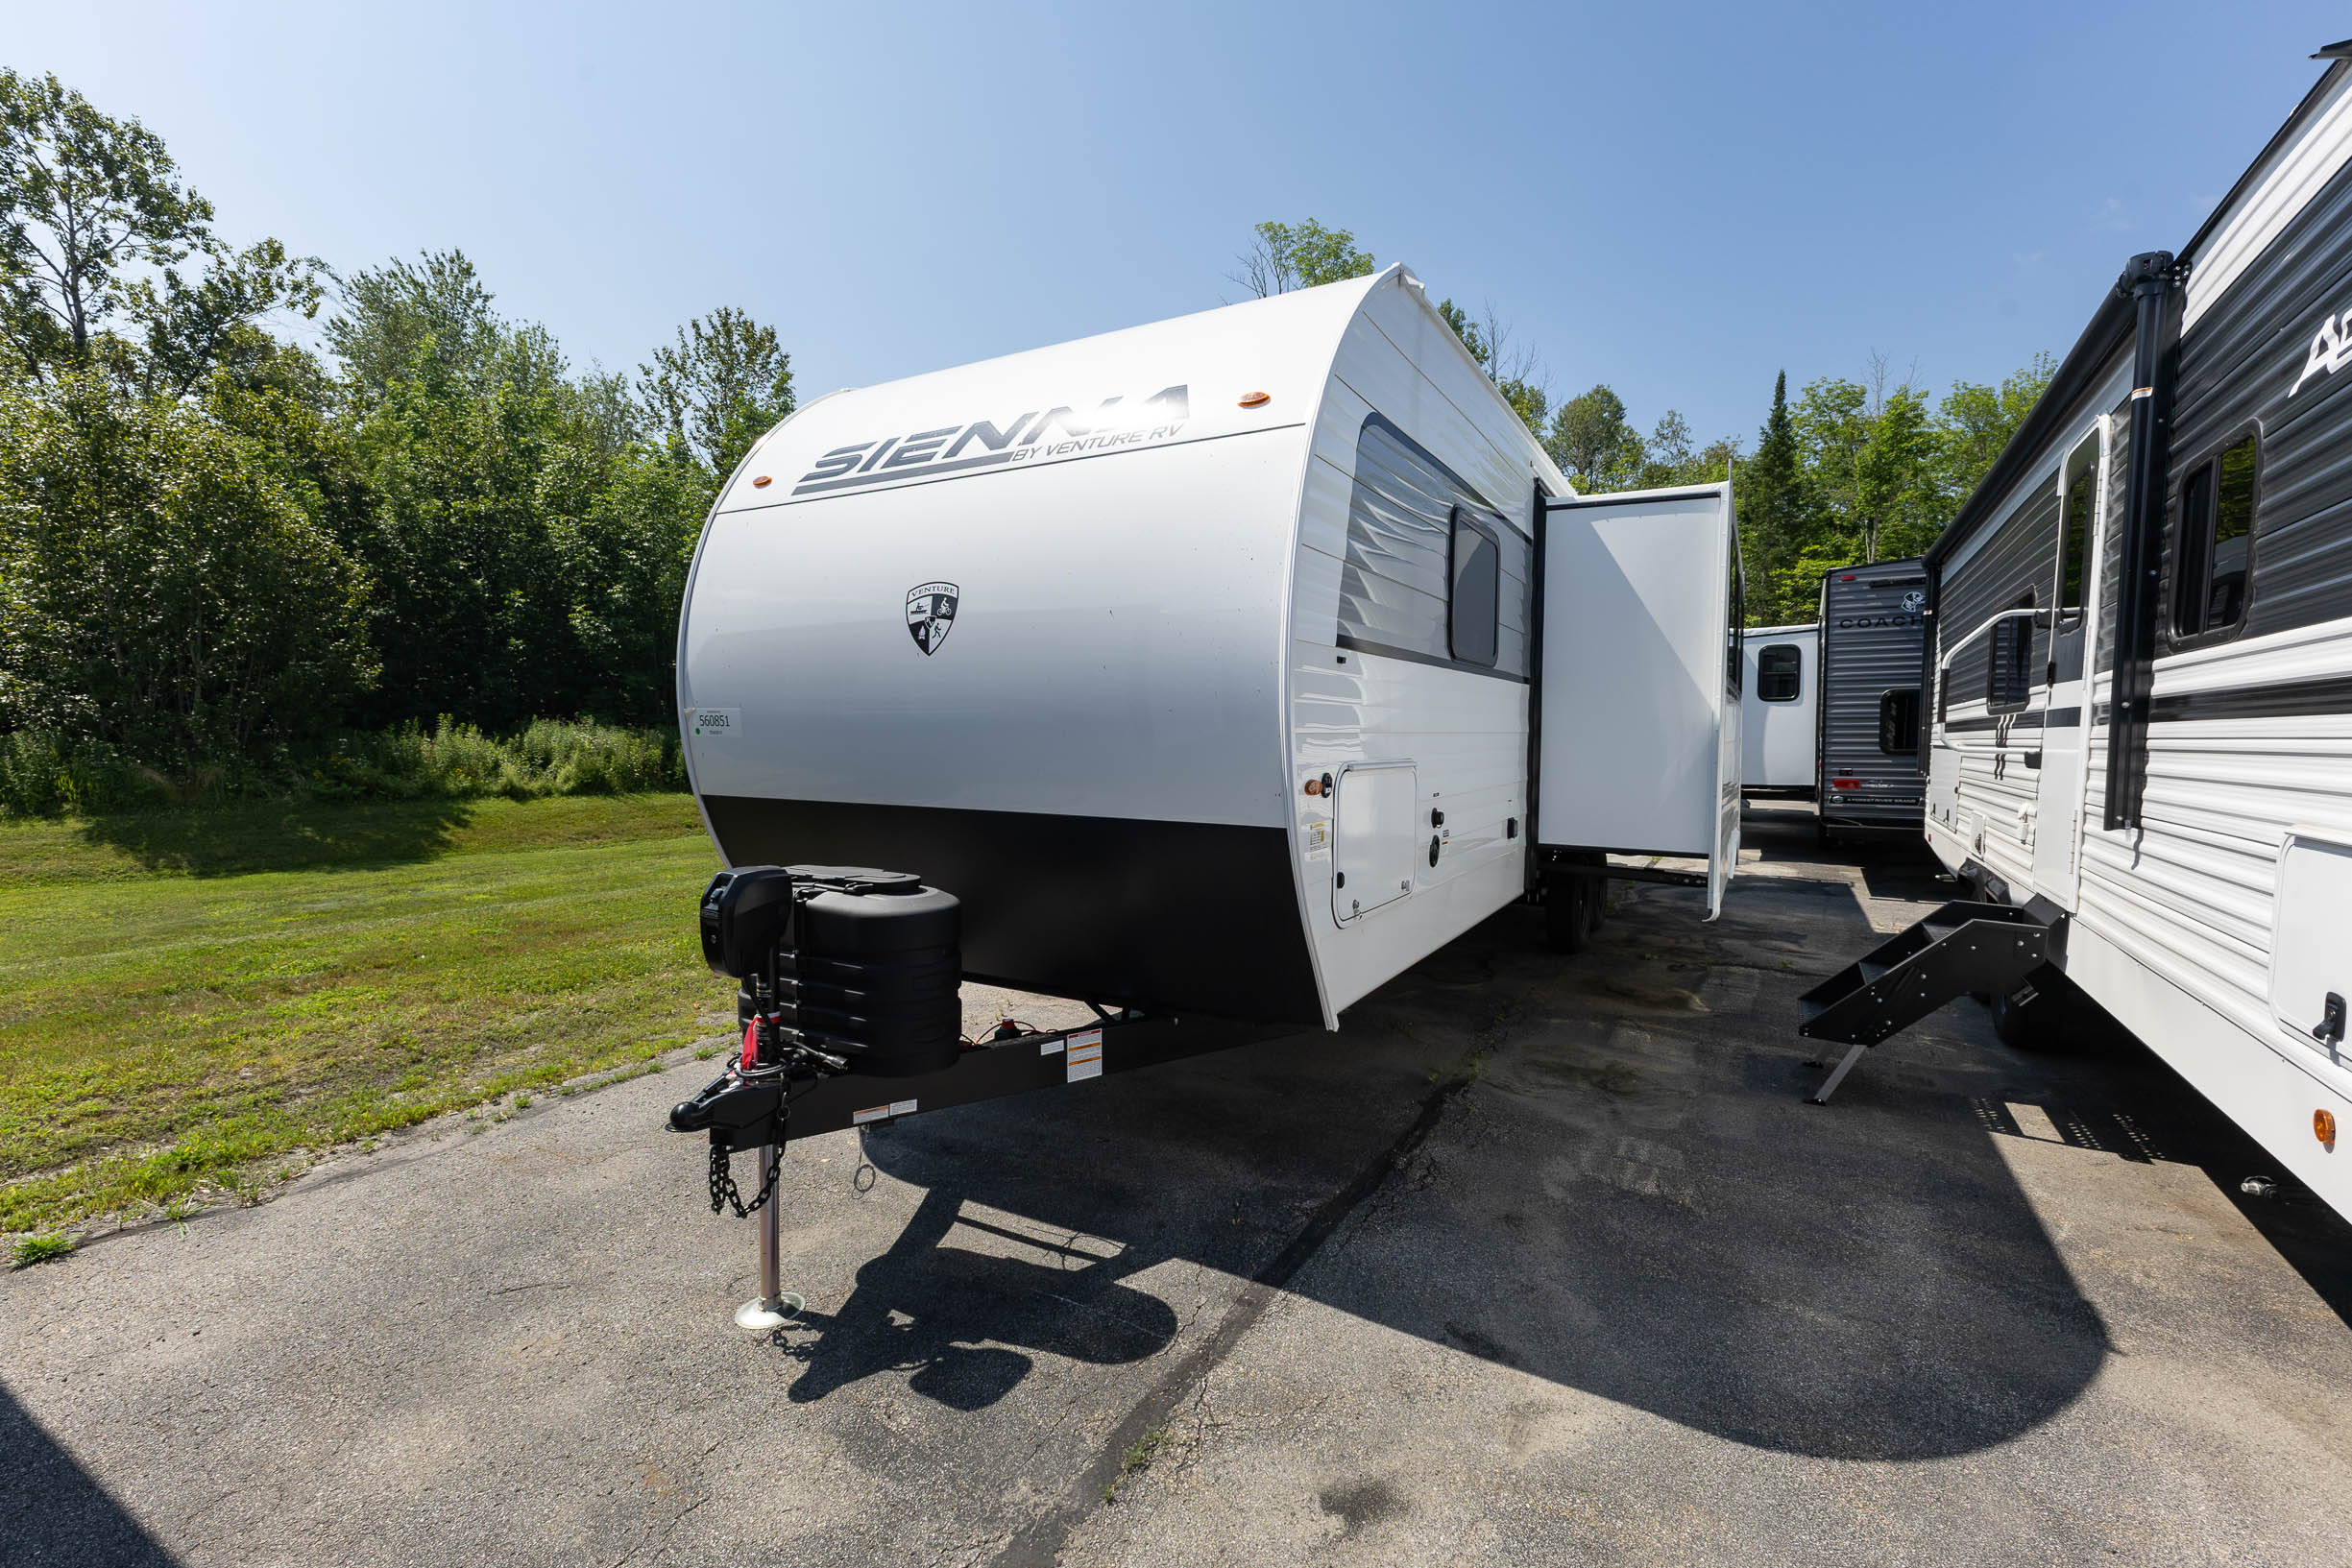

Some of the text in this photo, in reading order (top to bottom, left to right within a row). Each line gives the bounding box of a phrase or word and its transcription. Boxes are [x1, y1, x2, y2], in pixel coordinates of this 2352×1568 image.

[1011, 423, 1184, 462] BY VENTURE RV
[911, 585, 956, 597] VENTURE
[699, 714, 730, 727] 560851
